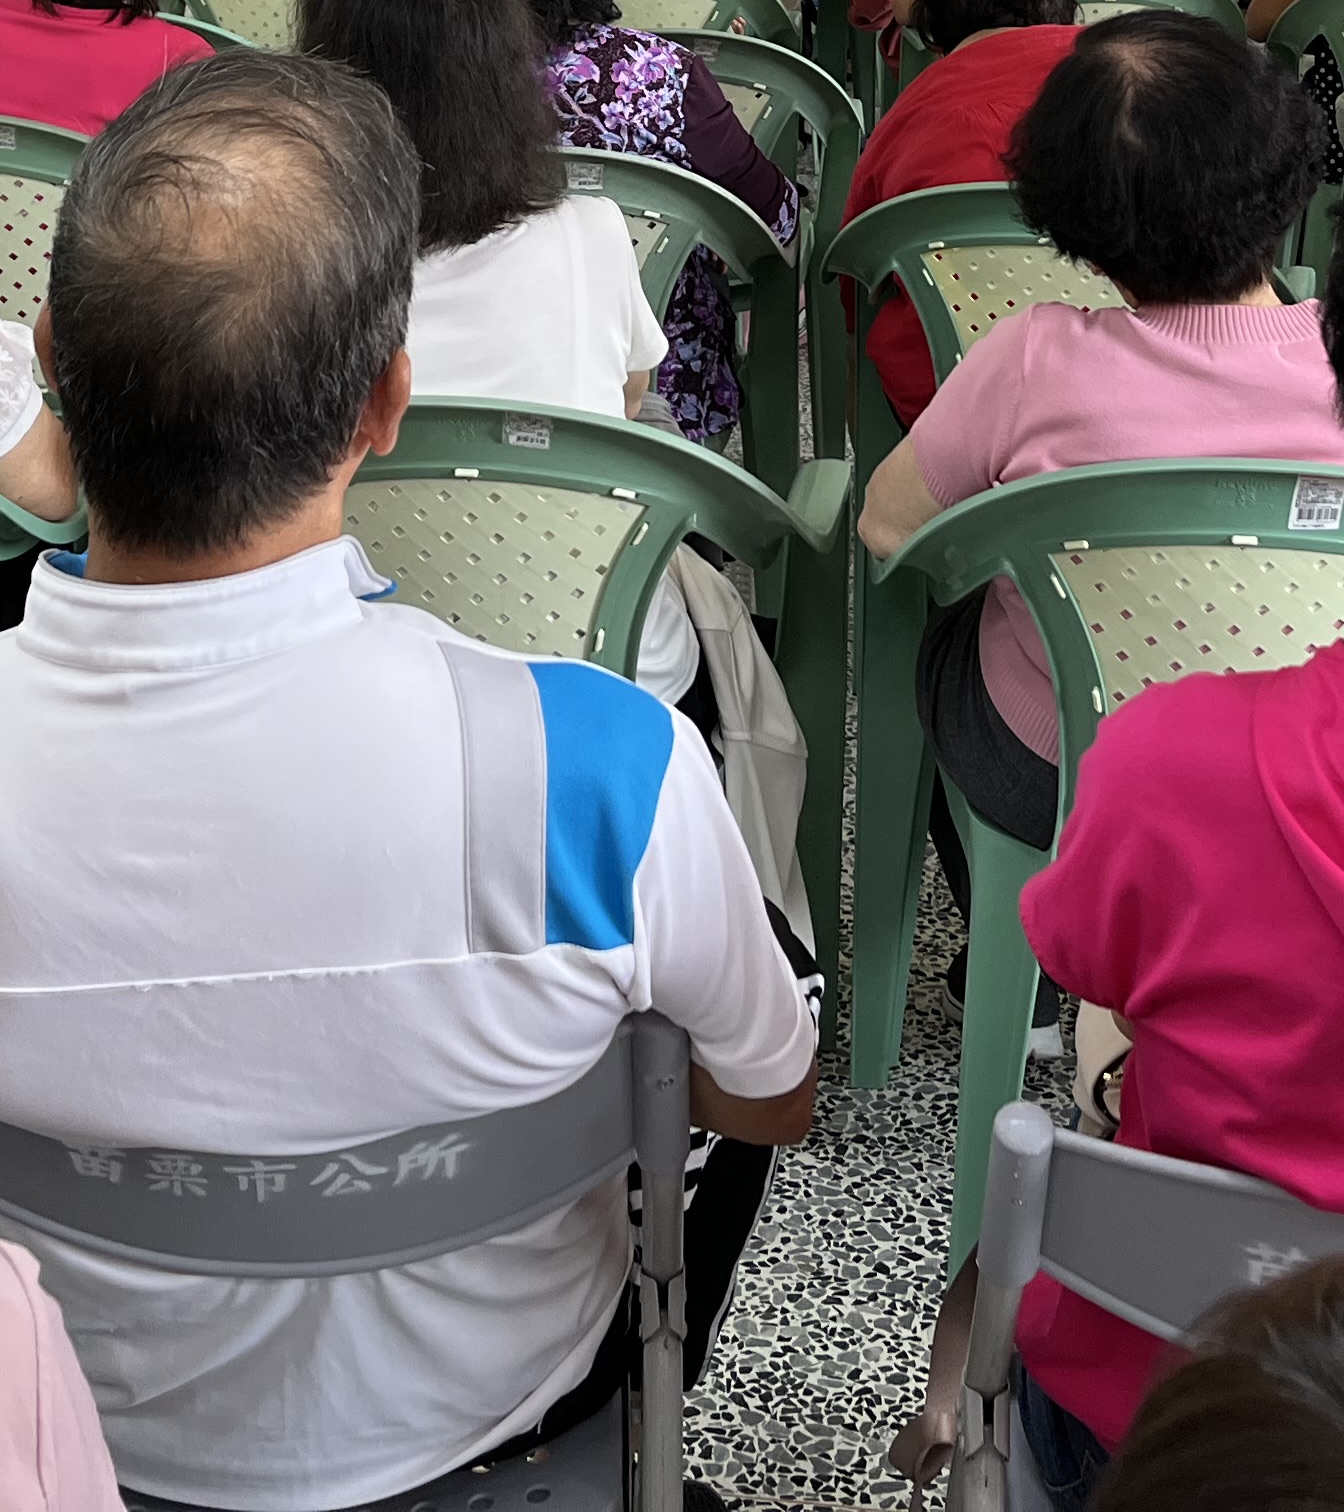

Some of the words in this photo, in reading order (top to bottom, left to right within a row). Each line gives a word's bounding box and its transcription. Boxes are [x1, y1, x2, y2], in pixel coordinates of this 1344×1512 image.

[64, 1133, 474, 1202] 苗栗市公所
